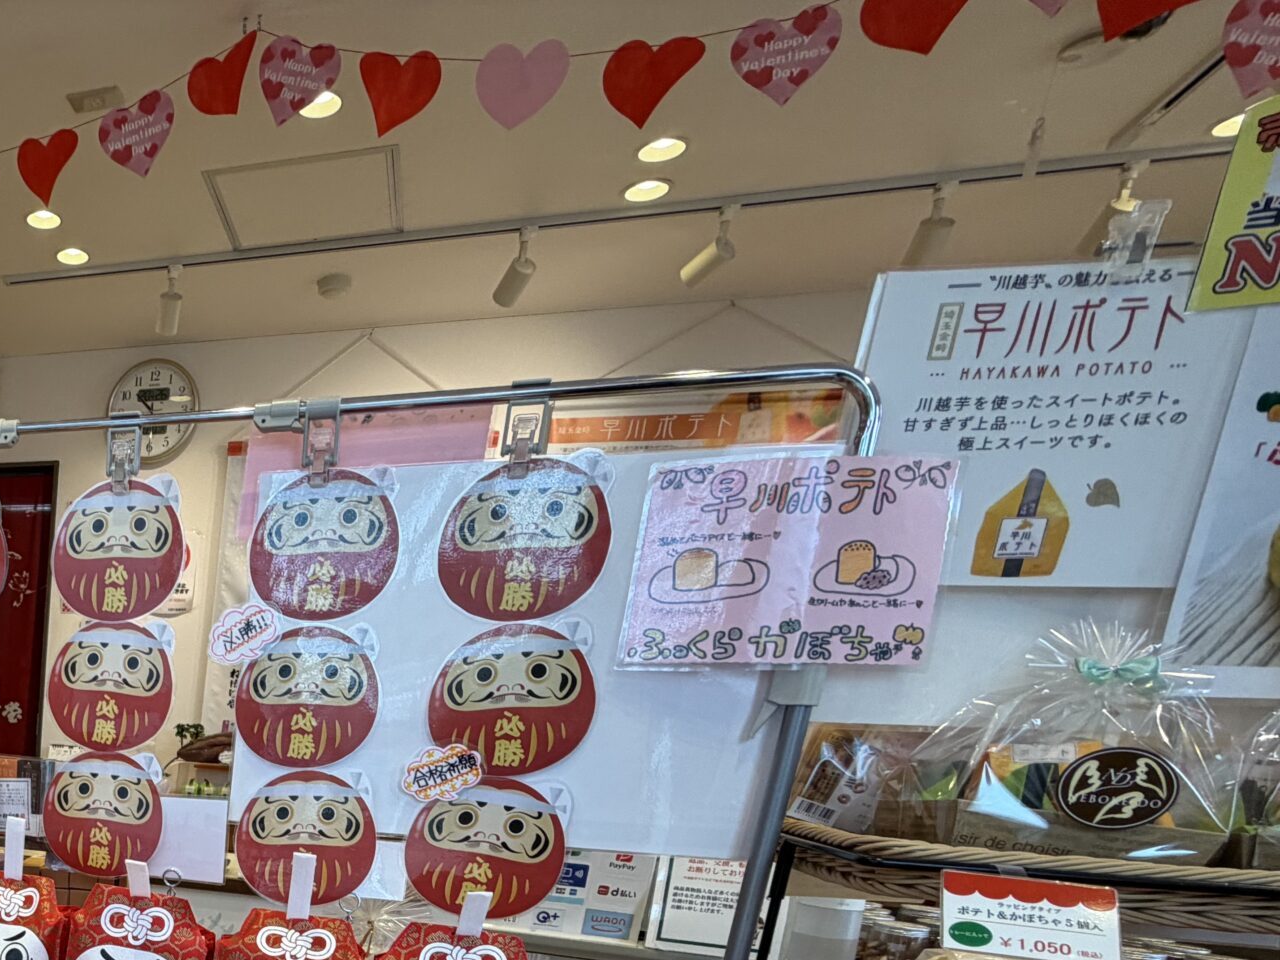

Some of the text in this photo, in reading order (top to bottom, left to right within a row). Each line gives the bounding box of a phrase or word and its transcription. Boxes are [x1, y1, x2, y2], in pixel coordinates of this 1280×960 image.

[763, 35, 812, 53] Happy
[284, 58, 320, 76] Happy
[773, 67, 801, 80] Day
[280, 86, 302, 102] Day
[121, 114, 155, 134] Happy
[131, 142, 153, 157] Day
[963, 294, 1186, 360] 早川ポテト
[135, 376, 143, 388] 11
[150, 369, 160, 382] 12
[959, 360, 1154, 381] HAYAKAWA POTATO
[122, 390, 131, 401] 10
[914, 390, 1181, 413] 川越芋を使ったスイートポテト。
[600, 413, 733, 441] 早川ポテト
[903, 410, 1188, 433] 甘すぎず上品…しっとりほくほくの
[957, 433, 1113, 452] 極上スイーツです。
[701, 459, 897, 526] 早川ポテト
[102, 560, 128, 614] 必勝
[304, 556, 336, 612] 必勝
[499, 553, 536, 612] 必勝
[222, 615, 271, 652] 必勝!!
[91, 694, 119, 745] 必勝
[286, 707, 318, 760] 必勝
[493, 709, 527, 768] 必勝
[412, 753, 479, 790] 合格祈願
[86, 821, 112, 869] 必勝
[984, 836, 1008, 850] de
[609, 861, 637, 873] PayPay
